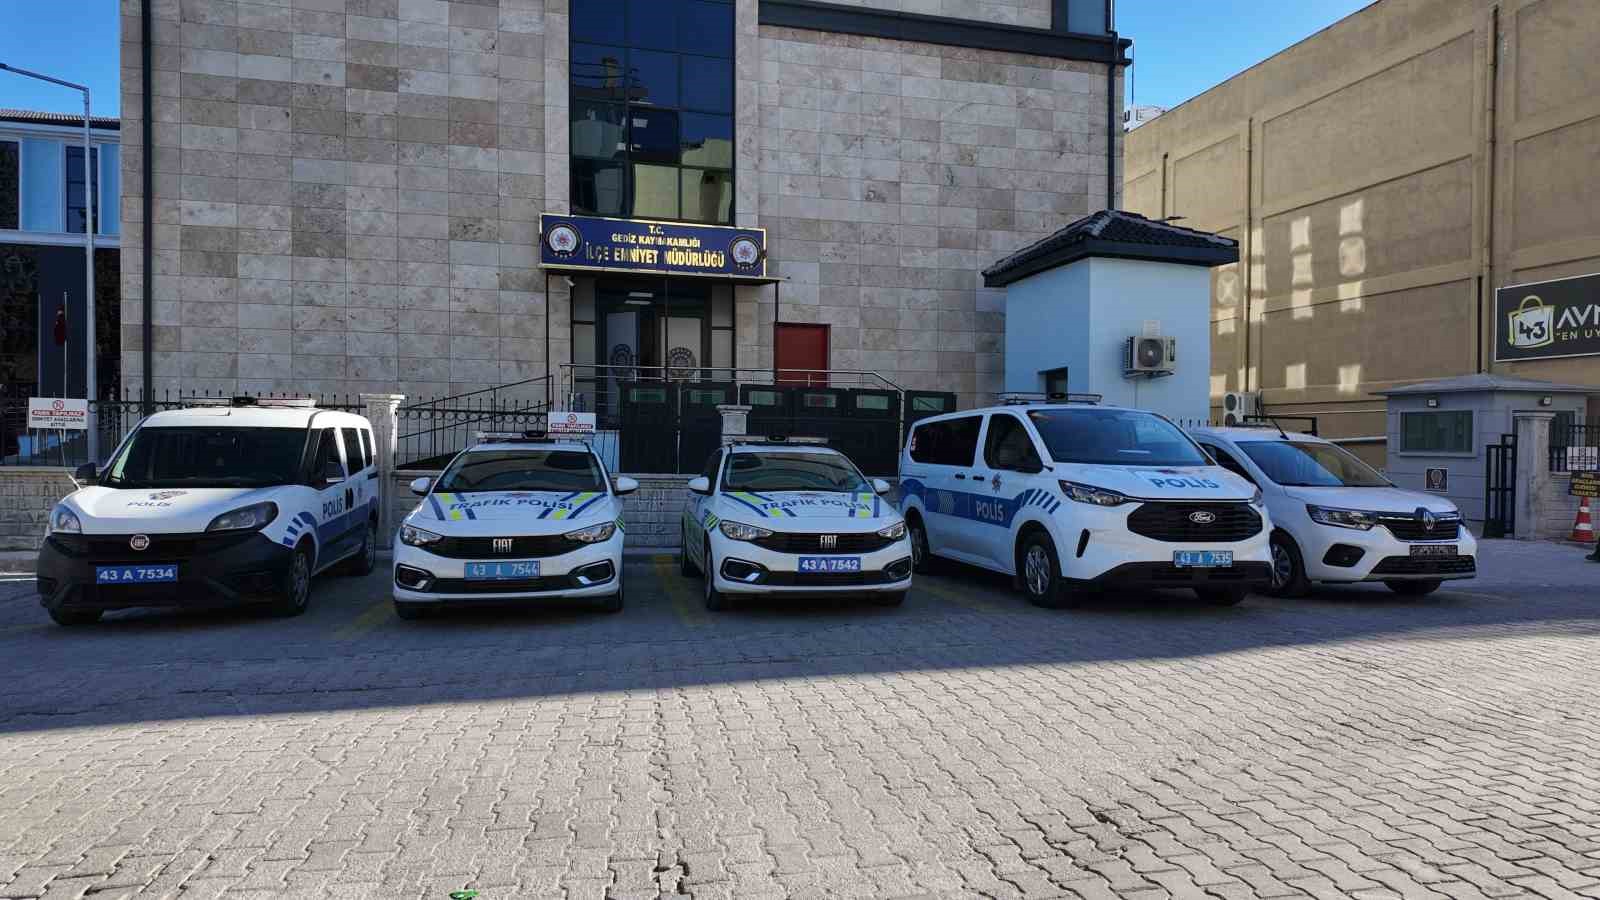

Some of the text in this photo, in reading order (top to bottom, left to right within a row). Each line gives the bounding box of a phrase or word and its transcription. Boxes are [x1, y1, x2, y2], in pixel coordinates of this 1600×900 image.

[649, 225, 664, 235] T.C.
[611, 233, 636, 244] GEDİZ
[585, 241, 725, 268] İLÇE EMNİYET MÜDÜRLÜĞÜ
[1519, 320, 1546, 340] 43
[976, 499, 1004, 521] POLİS
[492, 538, 513, 552] FIAT
[820, 535, 838, 548] FIAT
[473, 563, 538, 576] 43 A 7544
[801, 560, 858, 570] 43 A 7542
[99, 568, 174, 580] 43 A 7534
